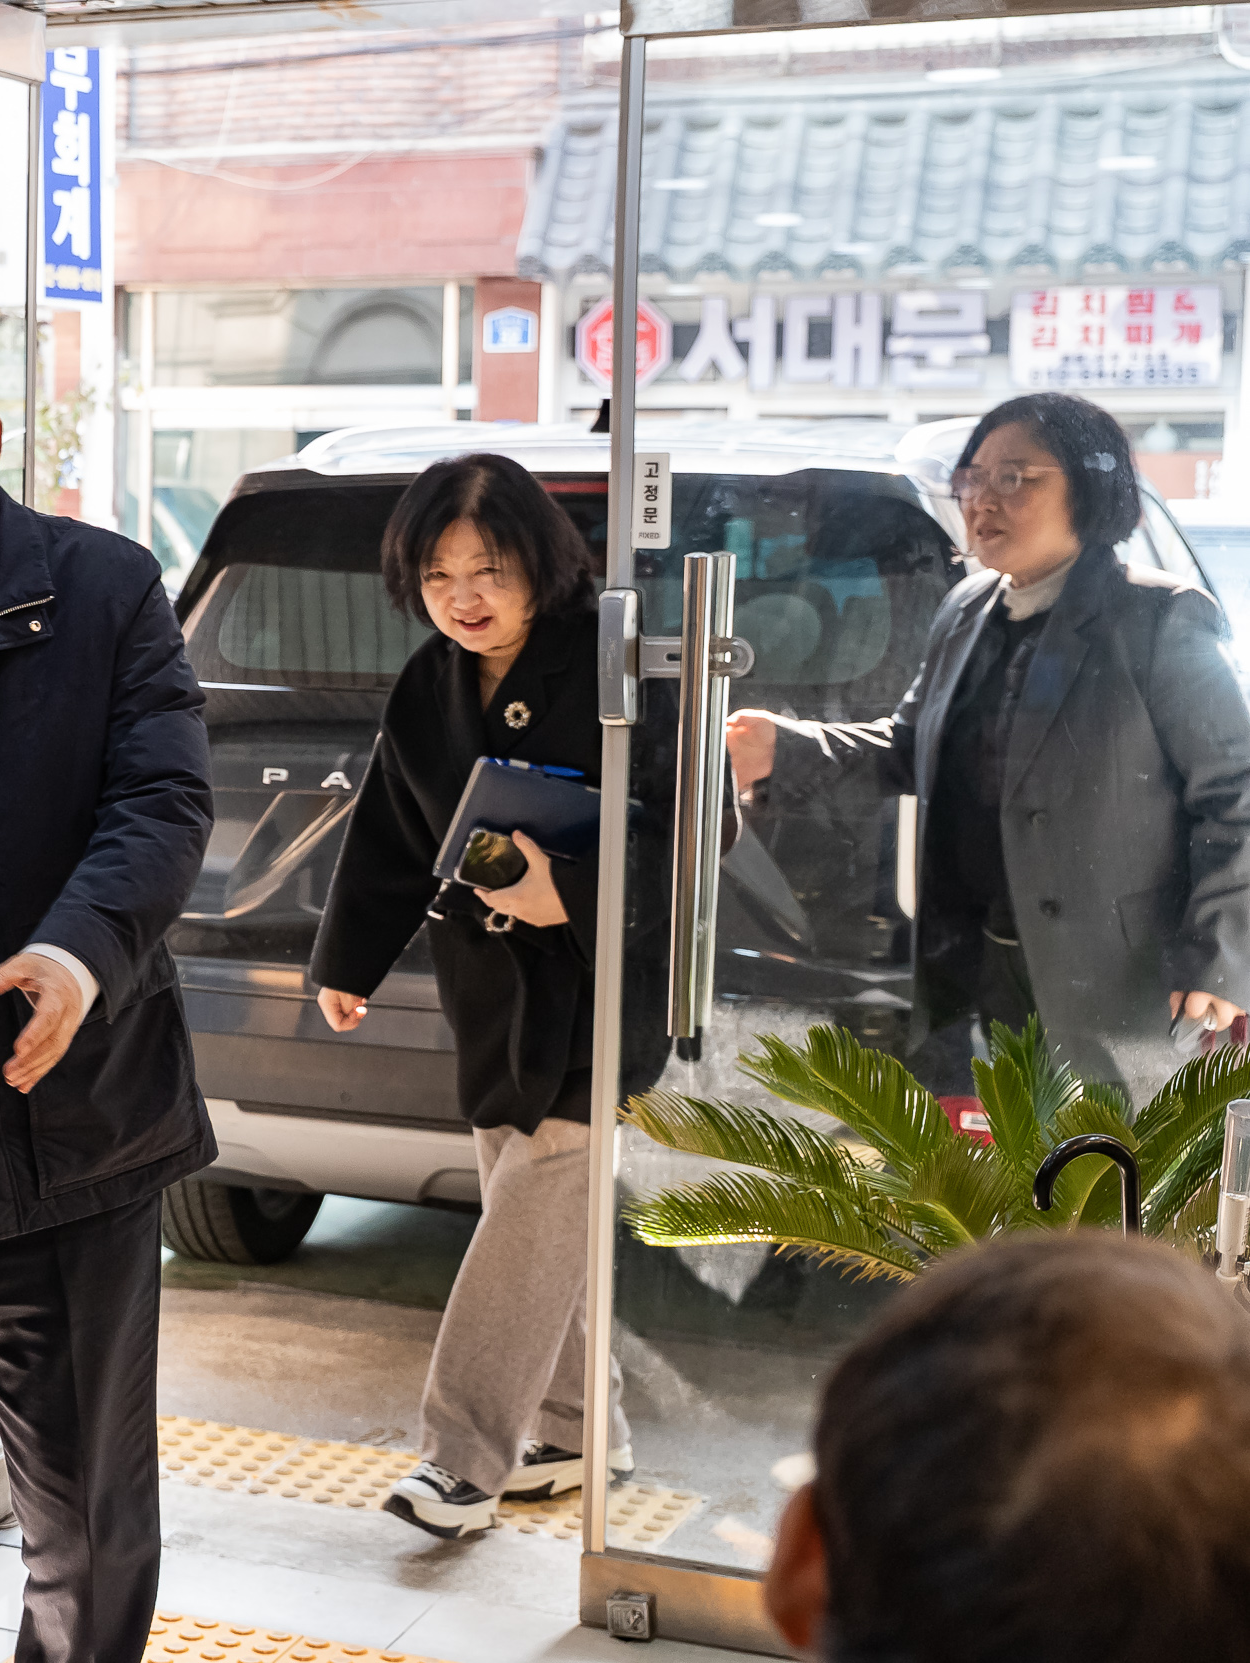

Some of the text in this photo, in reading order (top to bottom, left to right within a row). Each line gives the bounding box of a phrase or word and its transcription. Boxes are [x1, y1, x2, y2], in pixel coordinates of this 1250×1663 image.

[677, 293, 991, 388] 서대문
[643, 462, 659, 524] 고정문
[638, 532, 660, 540] FIXED
